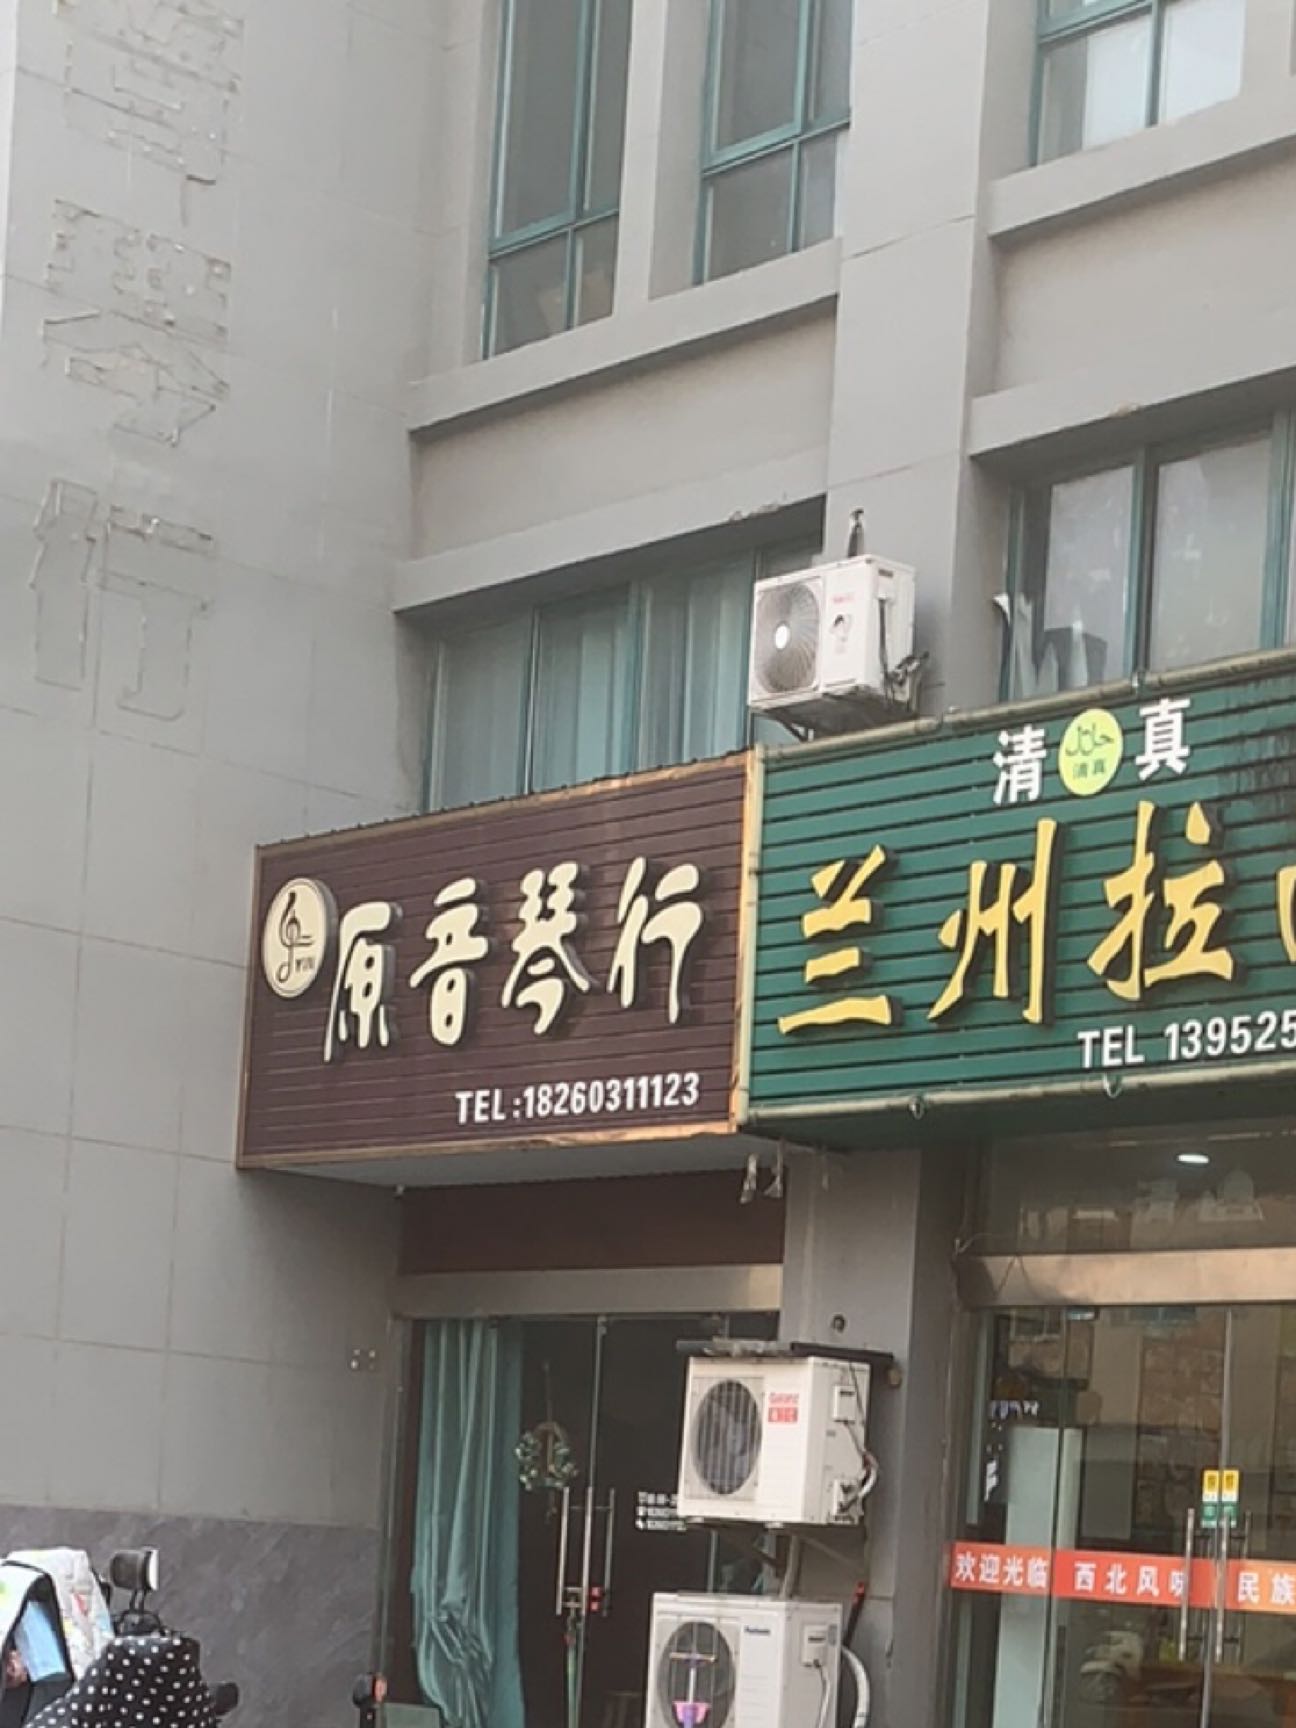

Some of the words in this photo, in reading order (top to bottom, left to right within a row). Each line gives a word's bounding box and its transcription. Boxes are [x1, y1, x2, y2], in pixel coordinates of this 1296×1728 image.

[322, 856, 703, 1062] 原音琴行
[1077, 1024, 1145, 1069] TEL
[955, 1551, 1049, 1588] 欢迎光临
